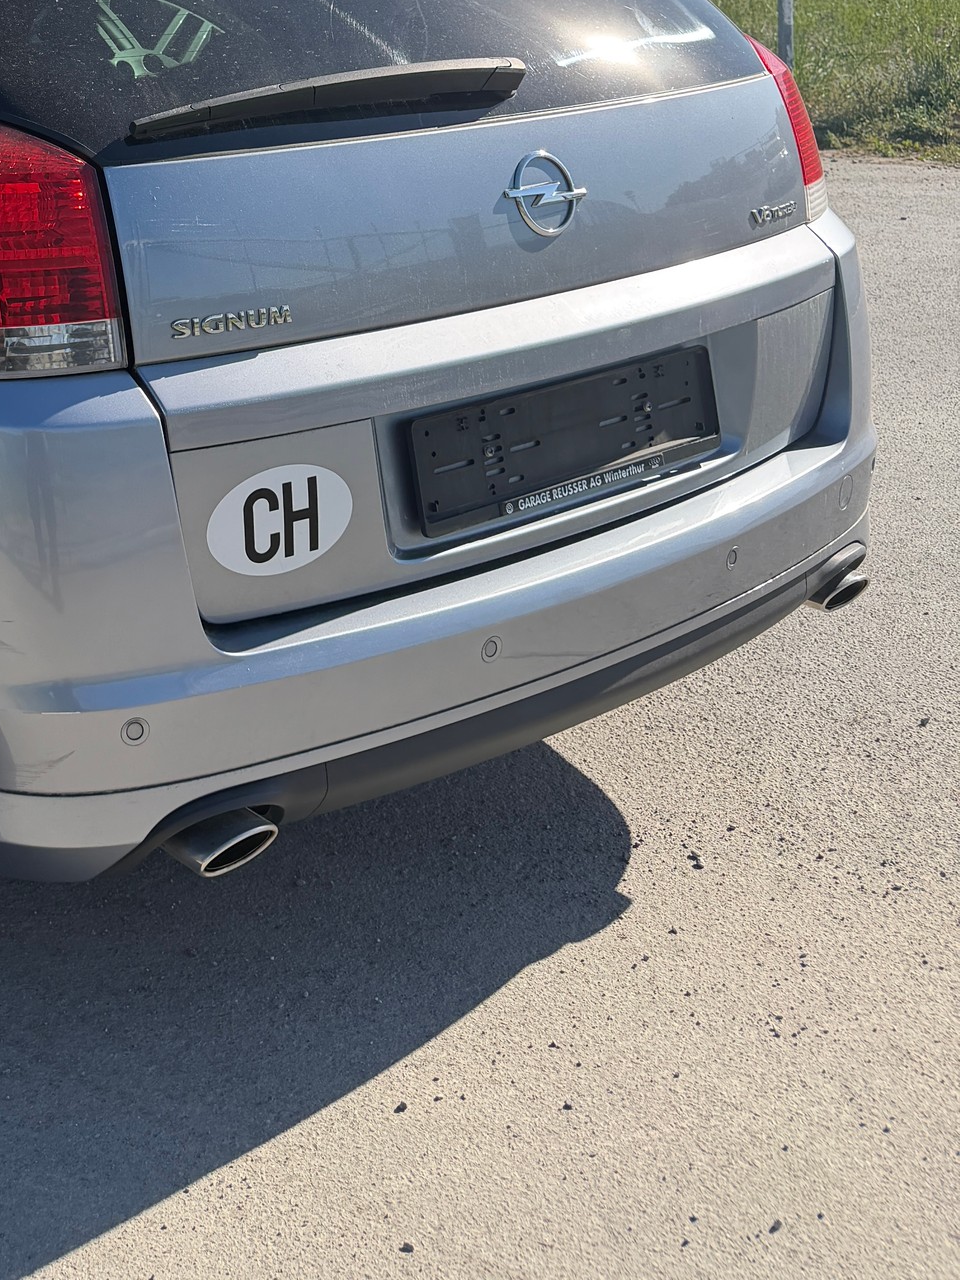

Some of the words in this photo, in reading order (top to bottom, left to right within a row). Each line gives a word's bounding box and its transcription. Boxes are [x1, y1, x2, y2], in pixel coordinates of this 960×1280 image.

[171, 304, 293, 339] SIGNUM
[518, 491, 552, 510] GARAGE
[552, 480, 588, 500] REUSSER
[590, 475, 602, 488] AG
[603, 463, 645, 484] Winterthur
[243, 475, 319, 563] CH
